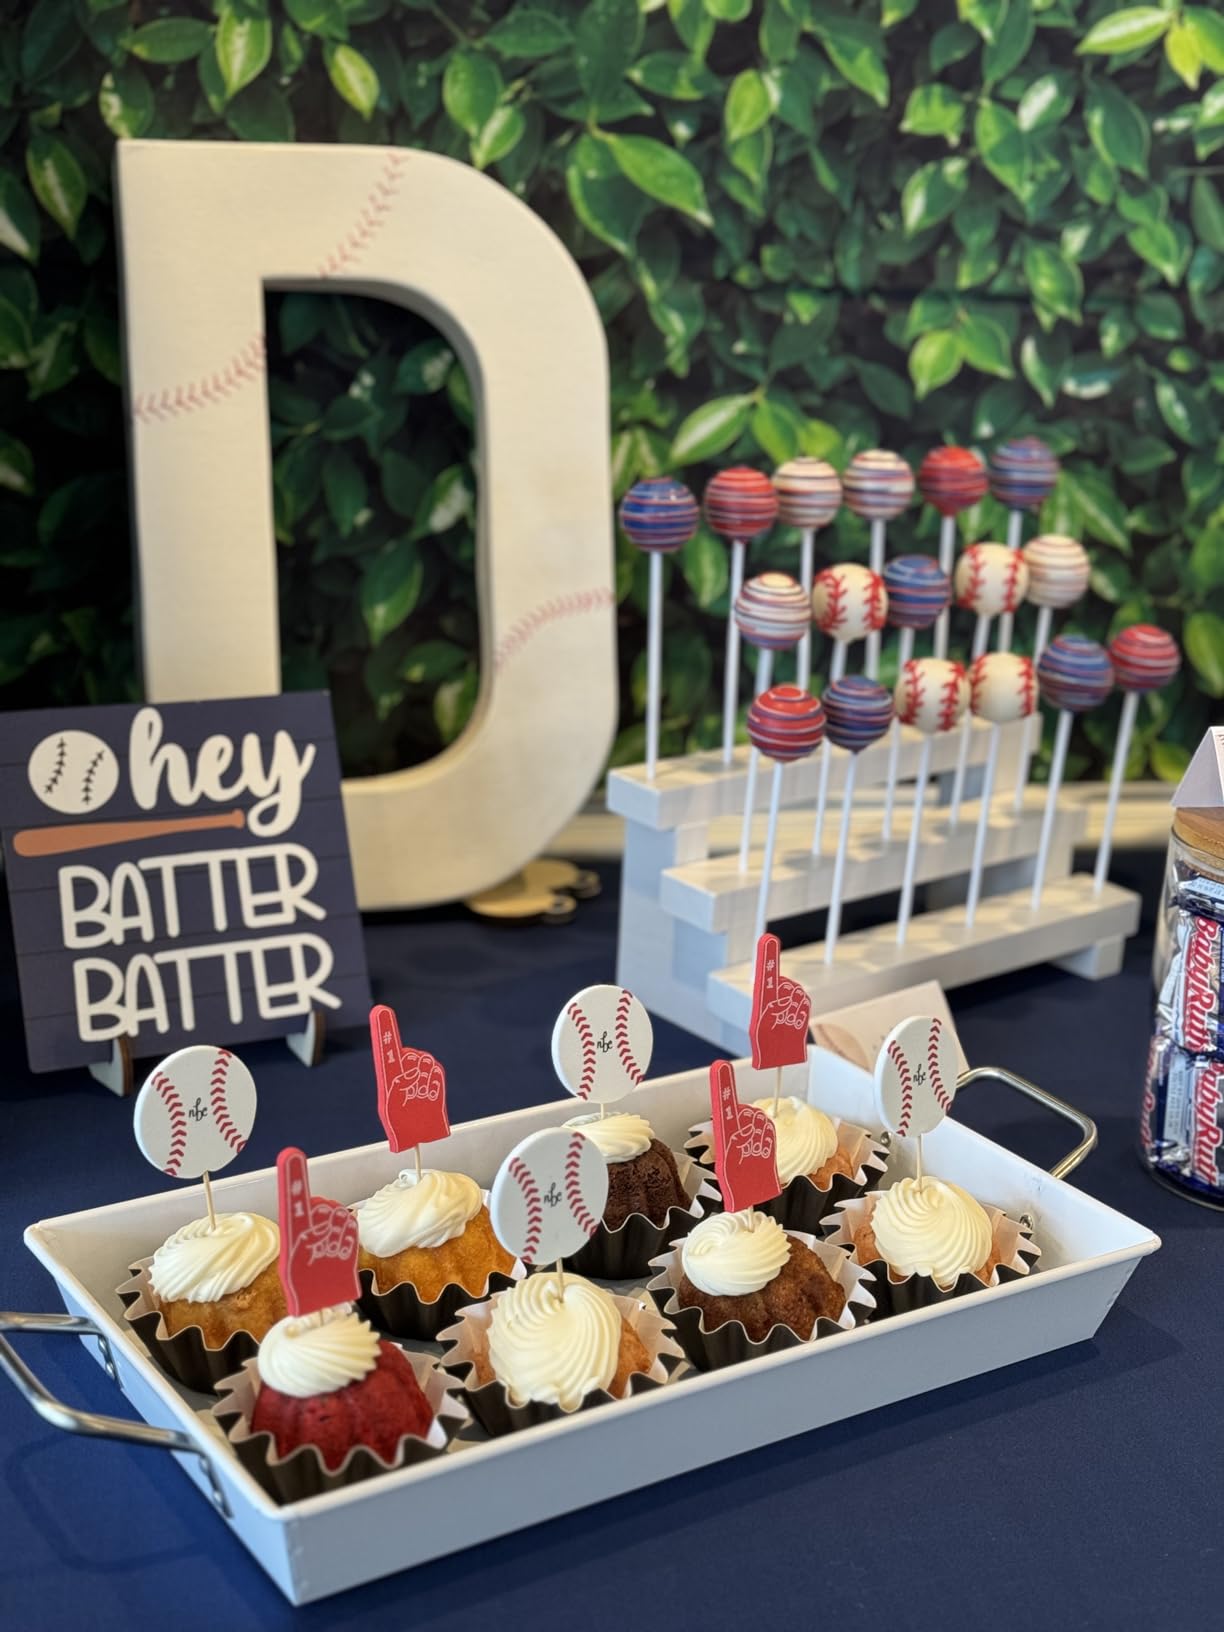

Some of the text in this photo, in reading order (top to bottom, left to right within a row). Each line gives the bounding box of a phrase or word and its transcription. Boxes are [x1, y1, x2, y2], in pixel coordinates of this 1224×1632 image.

[129, 707, 317, 838] hey
[58, 843, 327, 949] BATTER
[73, 933, 342, 1042] BATTER
